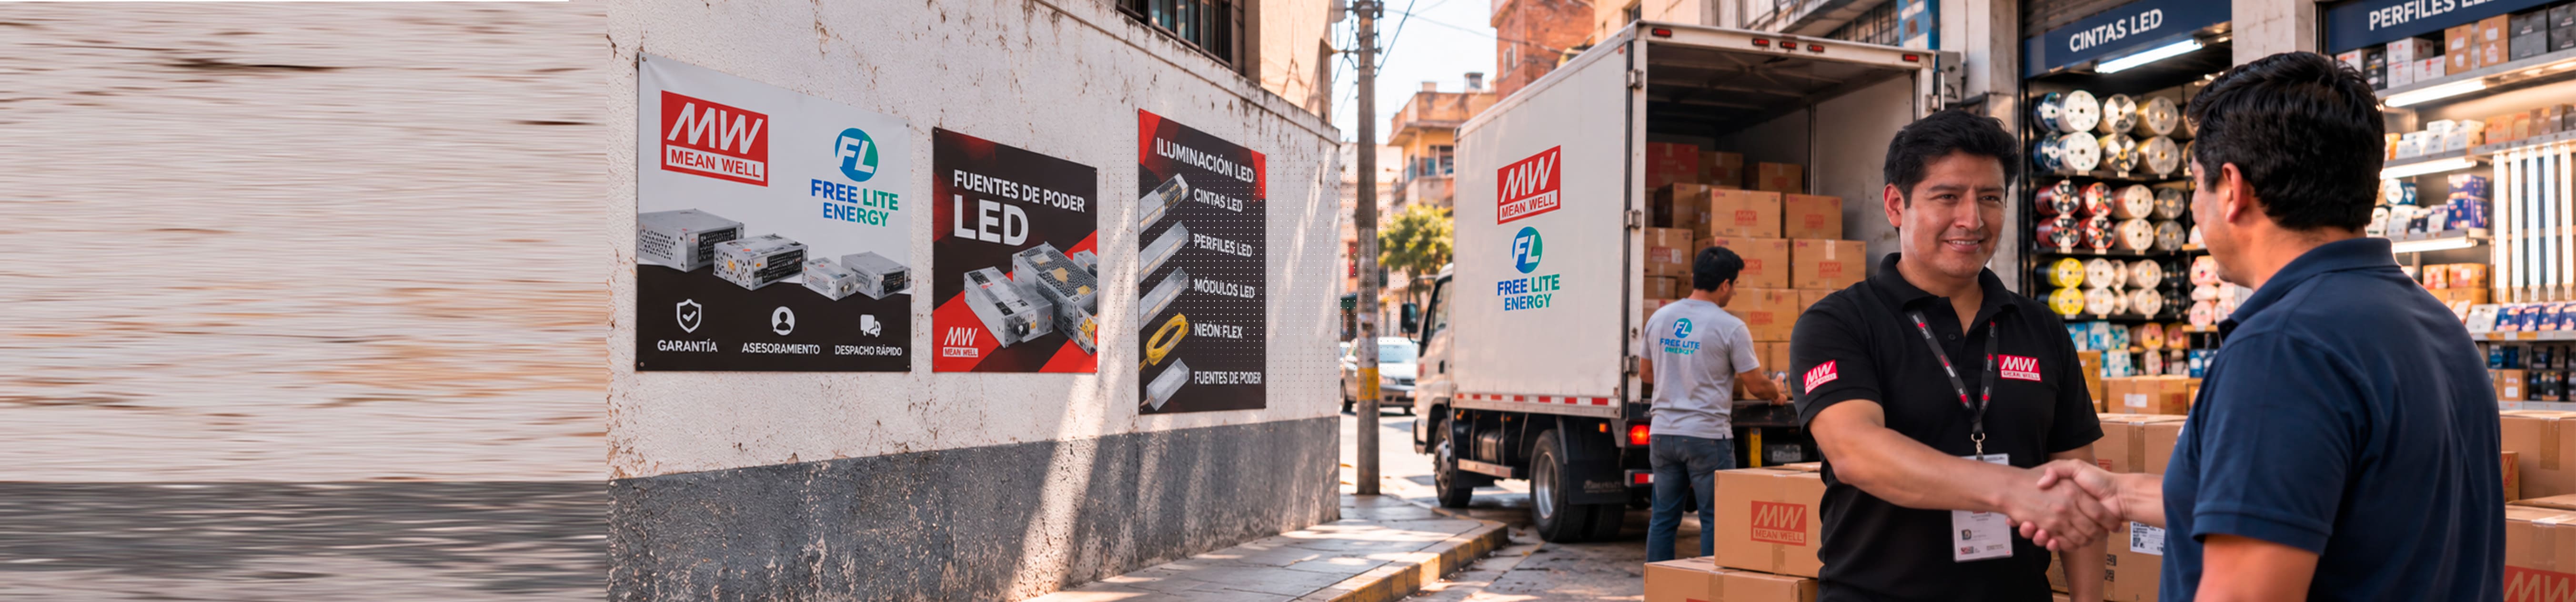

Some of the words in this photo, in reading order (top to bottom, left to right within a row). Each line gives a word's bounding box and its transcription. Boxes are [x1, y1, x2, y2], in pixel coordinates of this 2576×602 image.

[2369, 0, 2455, 31] PERFILES
[2069, 19, 2126, 52] CINTAS
[2131, 9, 2163, 35] LED
[667, 102, 764, 154] MW
[671, 149, 715, 170] MEAN
[722, 158, 761, 178] WELL
[837, 135, 875, 174] FL
[1157, 137, 1233, 177] ILUMINACIÓN
[1235, 164, 1254, 183] LED
[1500, 151, 1558, 203] MW
[811, 179, 857, 204] FREE
[863, 188, 899, 211] LITE
[954, 170, 1018, 199] FUENTES
[1023, 185, 1039, 204] DE
[1044, 190, 1085, 213] PODER
[1194, 188, 1226, 208] CINTAS
[1227, 197, 1243, 212] LED
[823, 203, 889, 227] ENERGY
[1502, 202, 1526, 218] MEAN
[1529, 194, 1554, 210] WELL
[954, 194, 1029, 246] LED
[1194, 233, 1235, 254] PERFILES
[1237, 243, 1252, 257] LED
[1513, 235, 1540, 266] FL
[1194, 276, 1238, 296] MÓDULOS
[1240, 286, 1255, 298] LED
[1497, 278, 1528, 296] FREE
[1531, 274, 1560, 292] LITE
[1504, 294, 1552, 311] ENERGY
[944, 327, 978, 347] MW
[1194, 321, 1220, 337] NEÓN
[1223, 326, 1243, 339] FLEX
[1674, 321, 1690, 335] FL
[657, 338, 718, 353] GARANTÍA
[742, 342, 820, 355] ASESORAMIENTO
[835, 345, 874, 356] DESPACHO
[876, 345, 902, 356] RÁPIDO
[1660, 338, 1680, 347] FREE
[1682, 341, 1700, 349] LITE
[1806, 361, 1833, 386] MW
[2001, 356, 2037, 372] MW
[1194, 371, 1228, 384] FUENTES
[1229, 372, 1239, 384] DE
[1240, 372, 1262, 384] PODER
[1754, 504, 1803, 529] MW
[1755, 530, 1778, 540] MEAN
[1781, 532, 1802, 541] WELL
